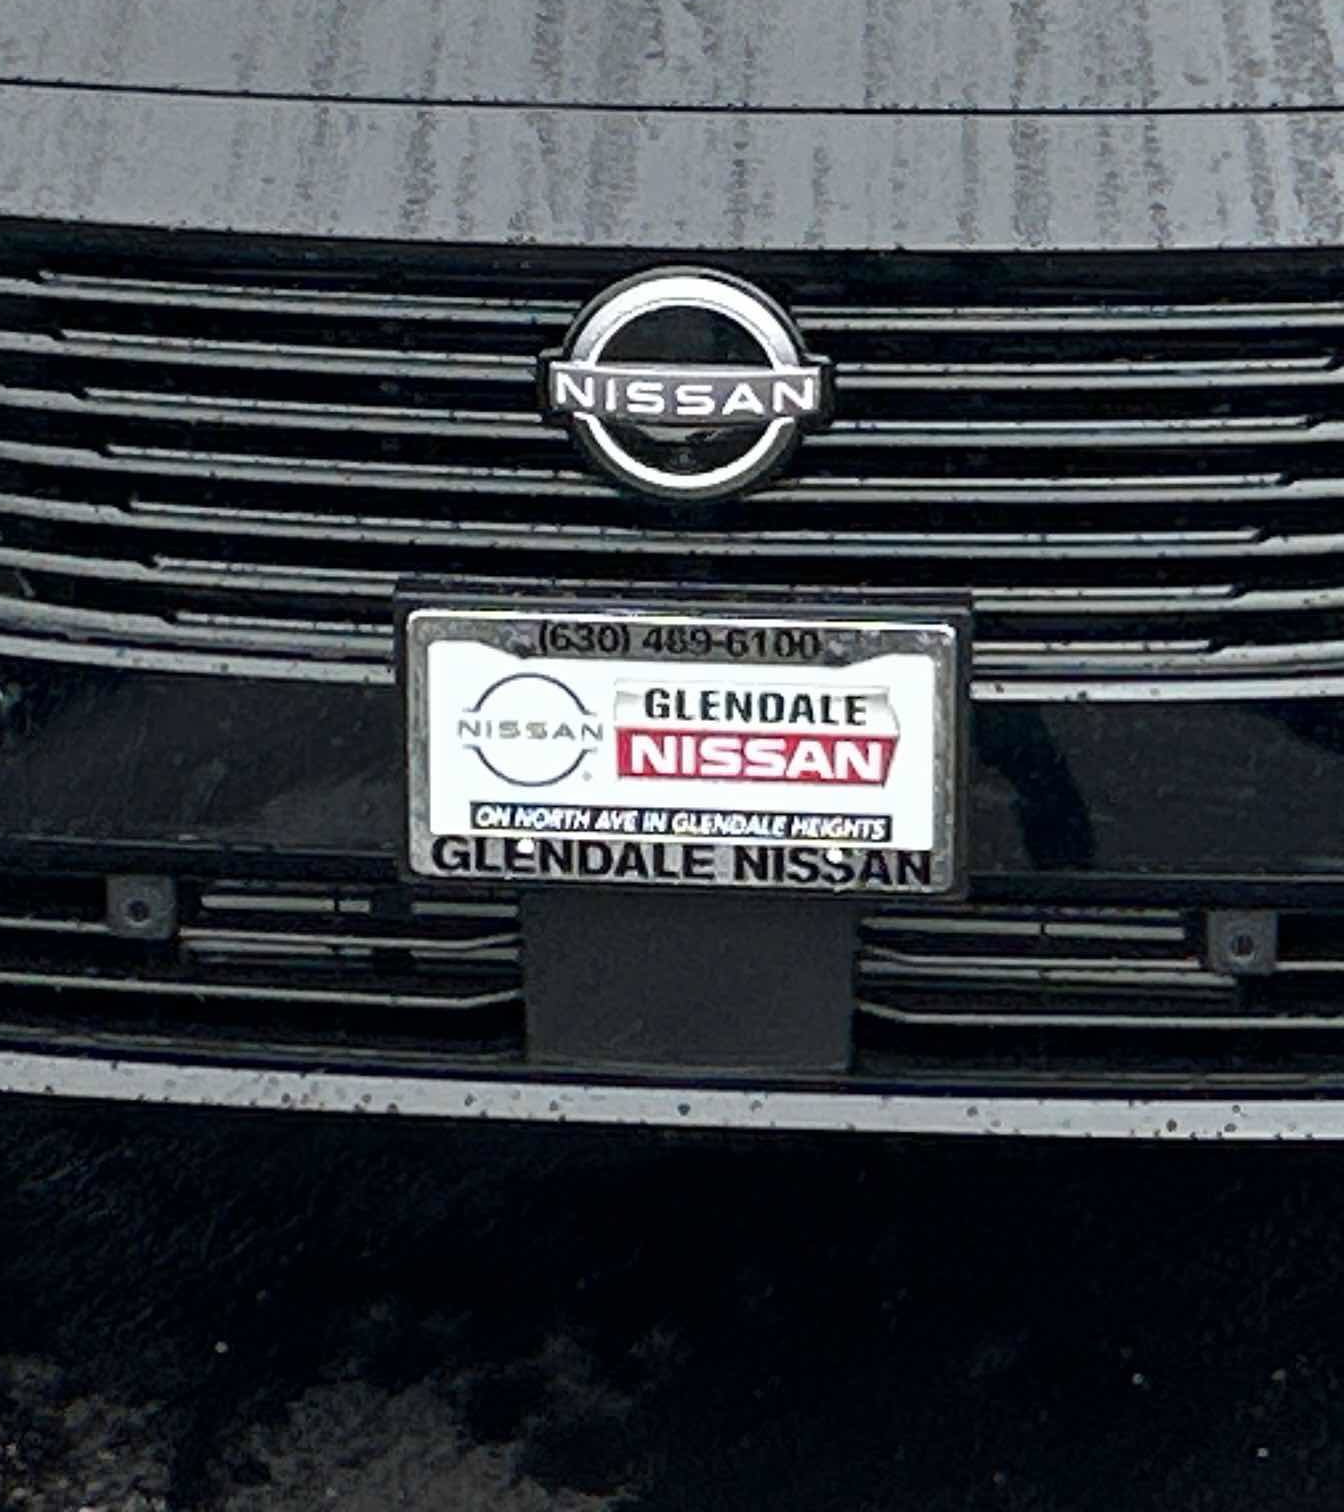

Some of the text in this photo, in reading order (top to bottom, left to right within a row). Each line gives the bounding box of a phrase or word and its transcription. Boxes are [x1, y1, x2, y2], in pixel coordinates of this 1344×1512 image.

[556, 372, 814, 415] NISSAN
[539, 622, 630, 655] (630)
[644, 688, 866, 726] GLENDALE
[458, 720, 604, 741] NISSAN
[631, 734, 882, 780] NISSAN
[475, 807, 887, 839] ON NORTH AVE IN GLENDALE HEIGHTS
[432, 836, 931, 886] GLENDALE NISSAN
